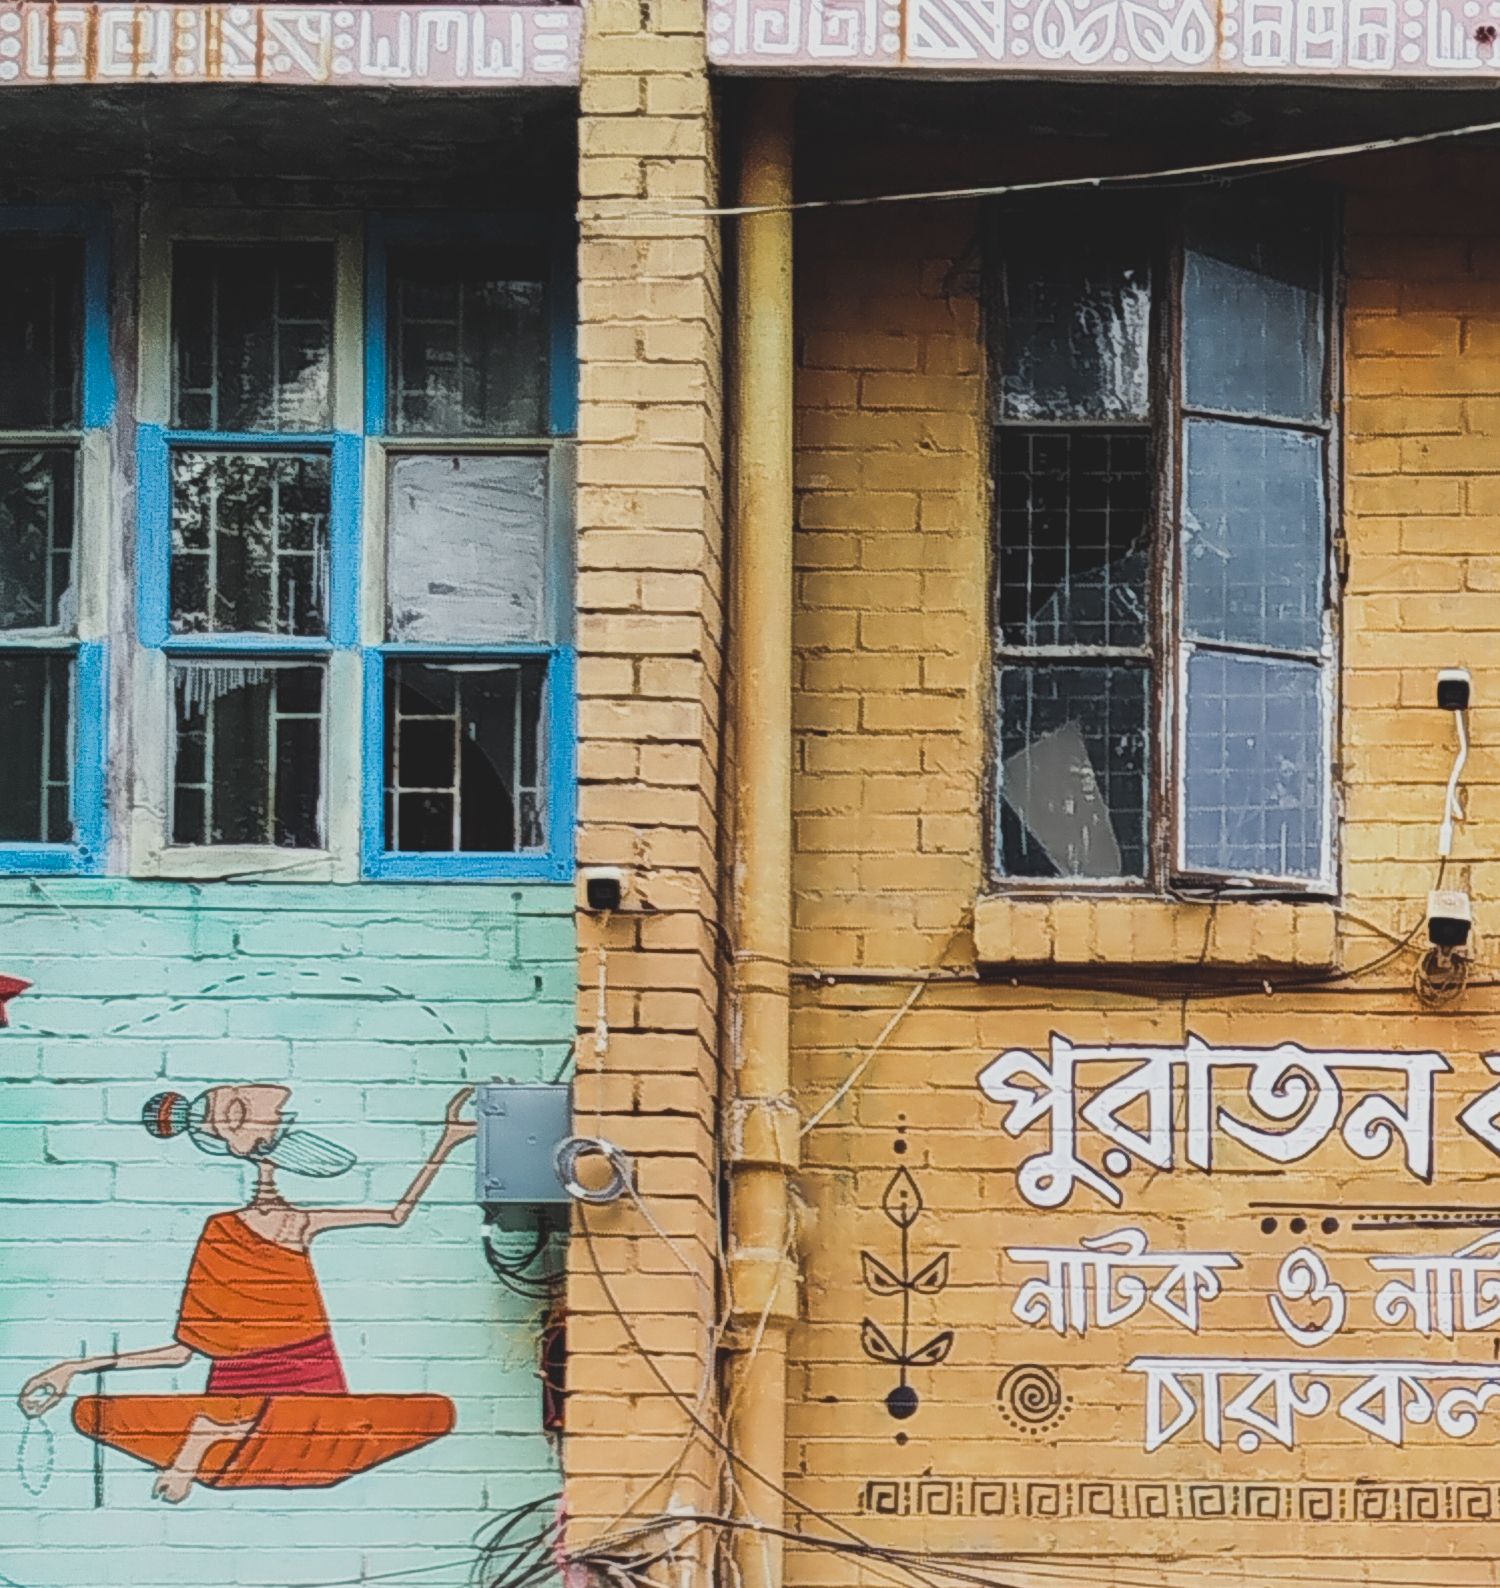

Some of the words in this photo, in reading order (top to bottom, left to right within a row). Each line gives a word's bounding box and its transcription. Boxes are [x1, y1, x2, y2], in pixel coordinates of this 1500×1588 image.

[976, 1031, 1449, 1207] পুরাতন
[1004, 1226, 1241, 1337] নাটক
[1269, 1246, 1347, 1346] ও
